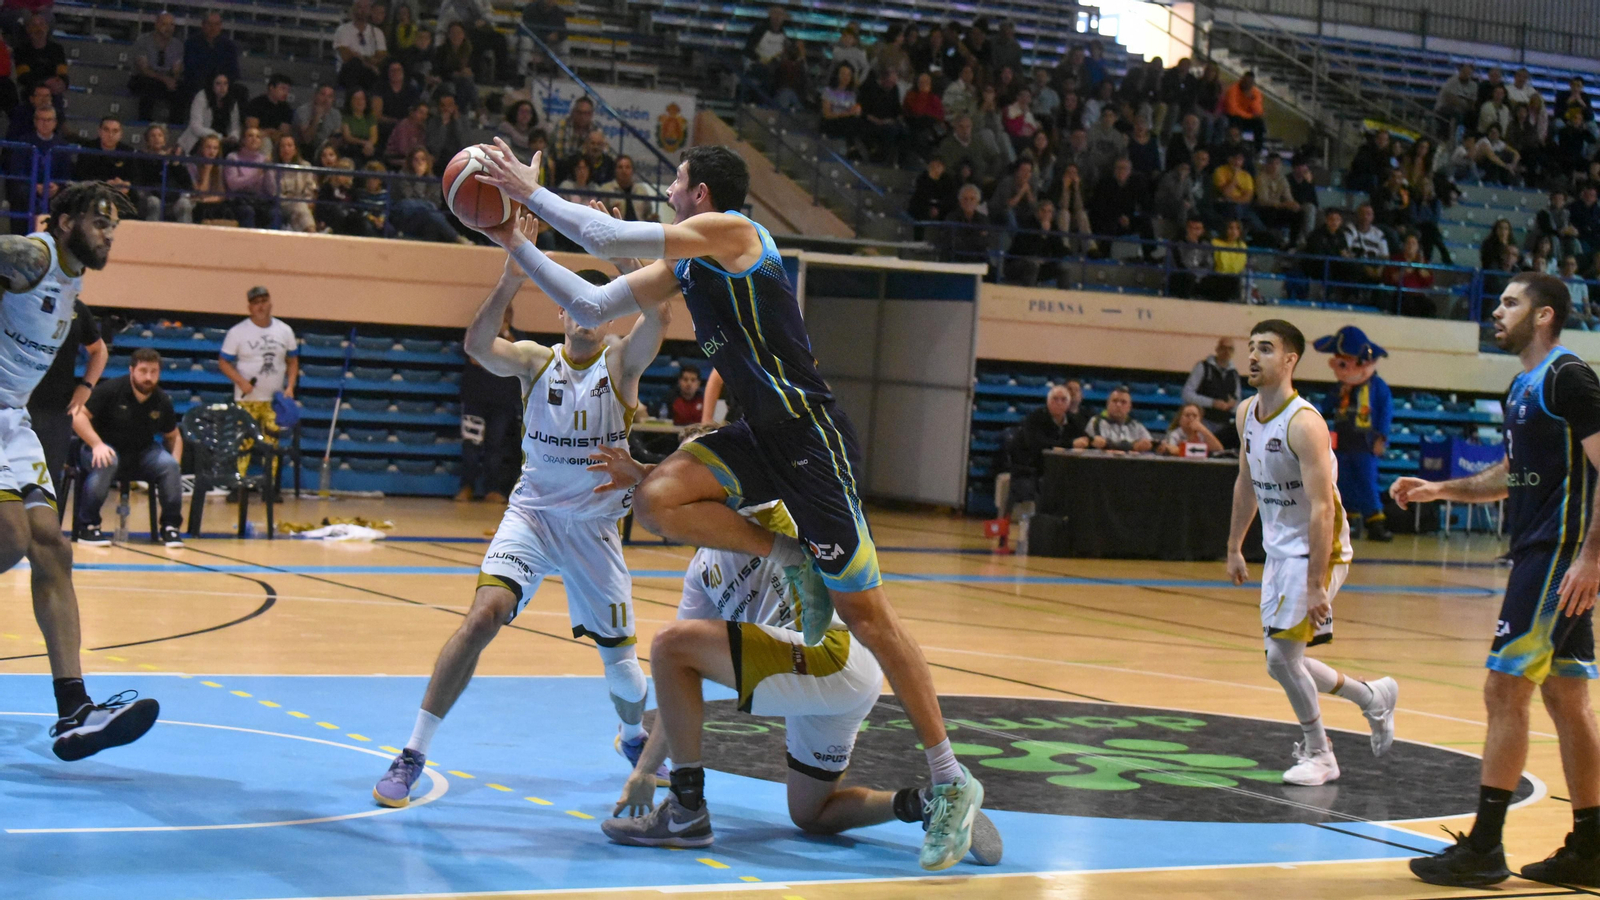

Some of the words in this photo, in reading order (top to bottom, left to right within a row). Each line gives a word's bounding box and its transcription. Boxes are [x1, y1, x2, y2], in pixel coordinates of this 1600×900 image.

[1028, 300, 1084, 315] PRENSA
[1136, 307, 1153, 320] TV
[573, 409, 587, 431] 11
[528, 431, 604, 447] JUARISTI
[608, 601, 628, 629] 11
